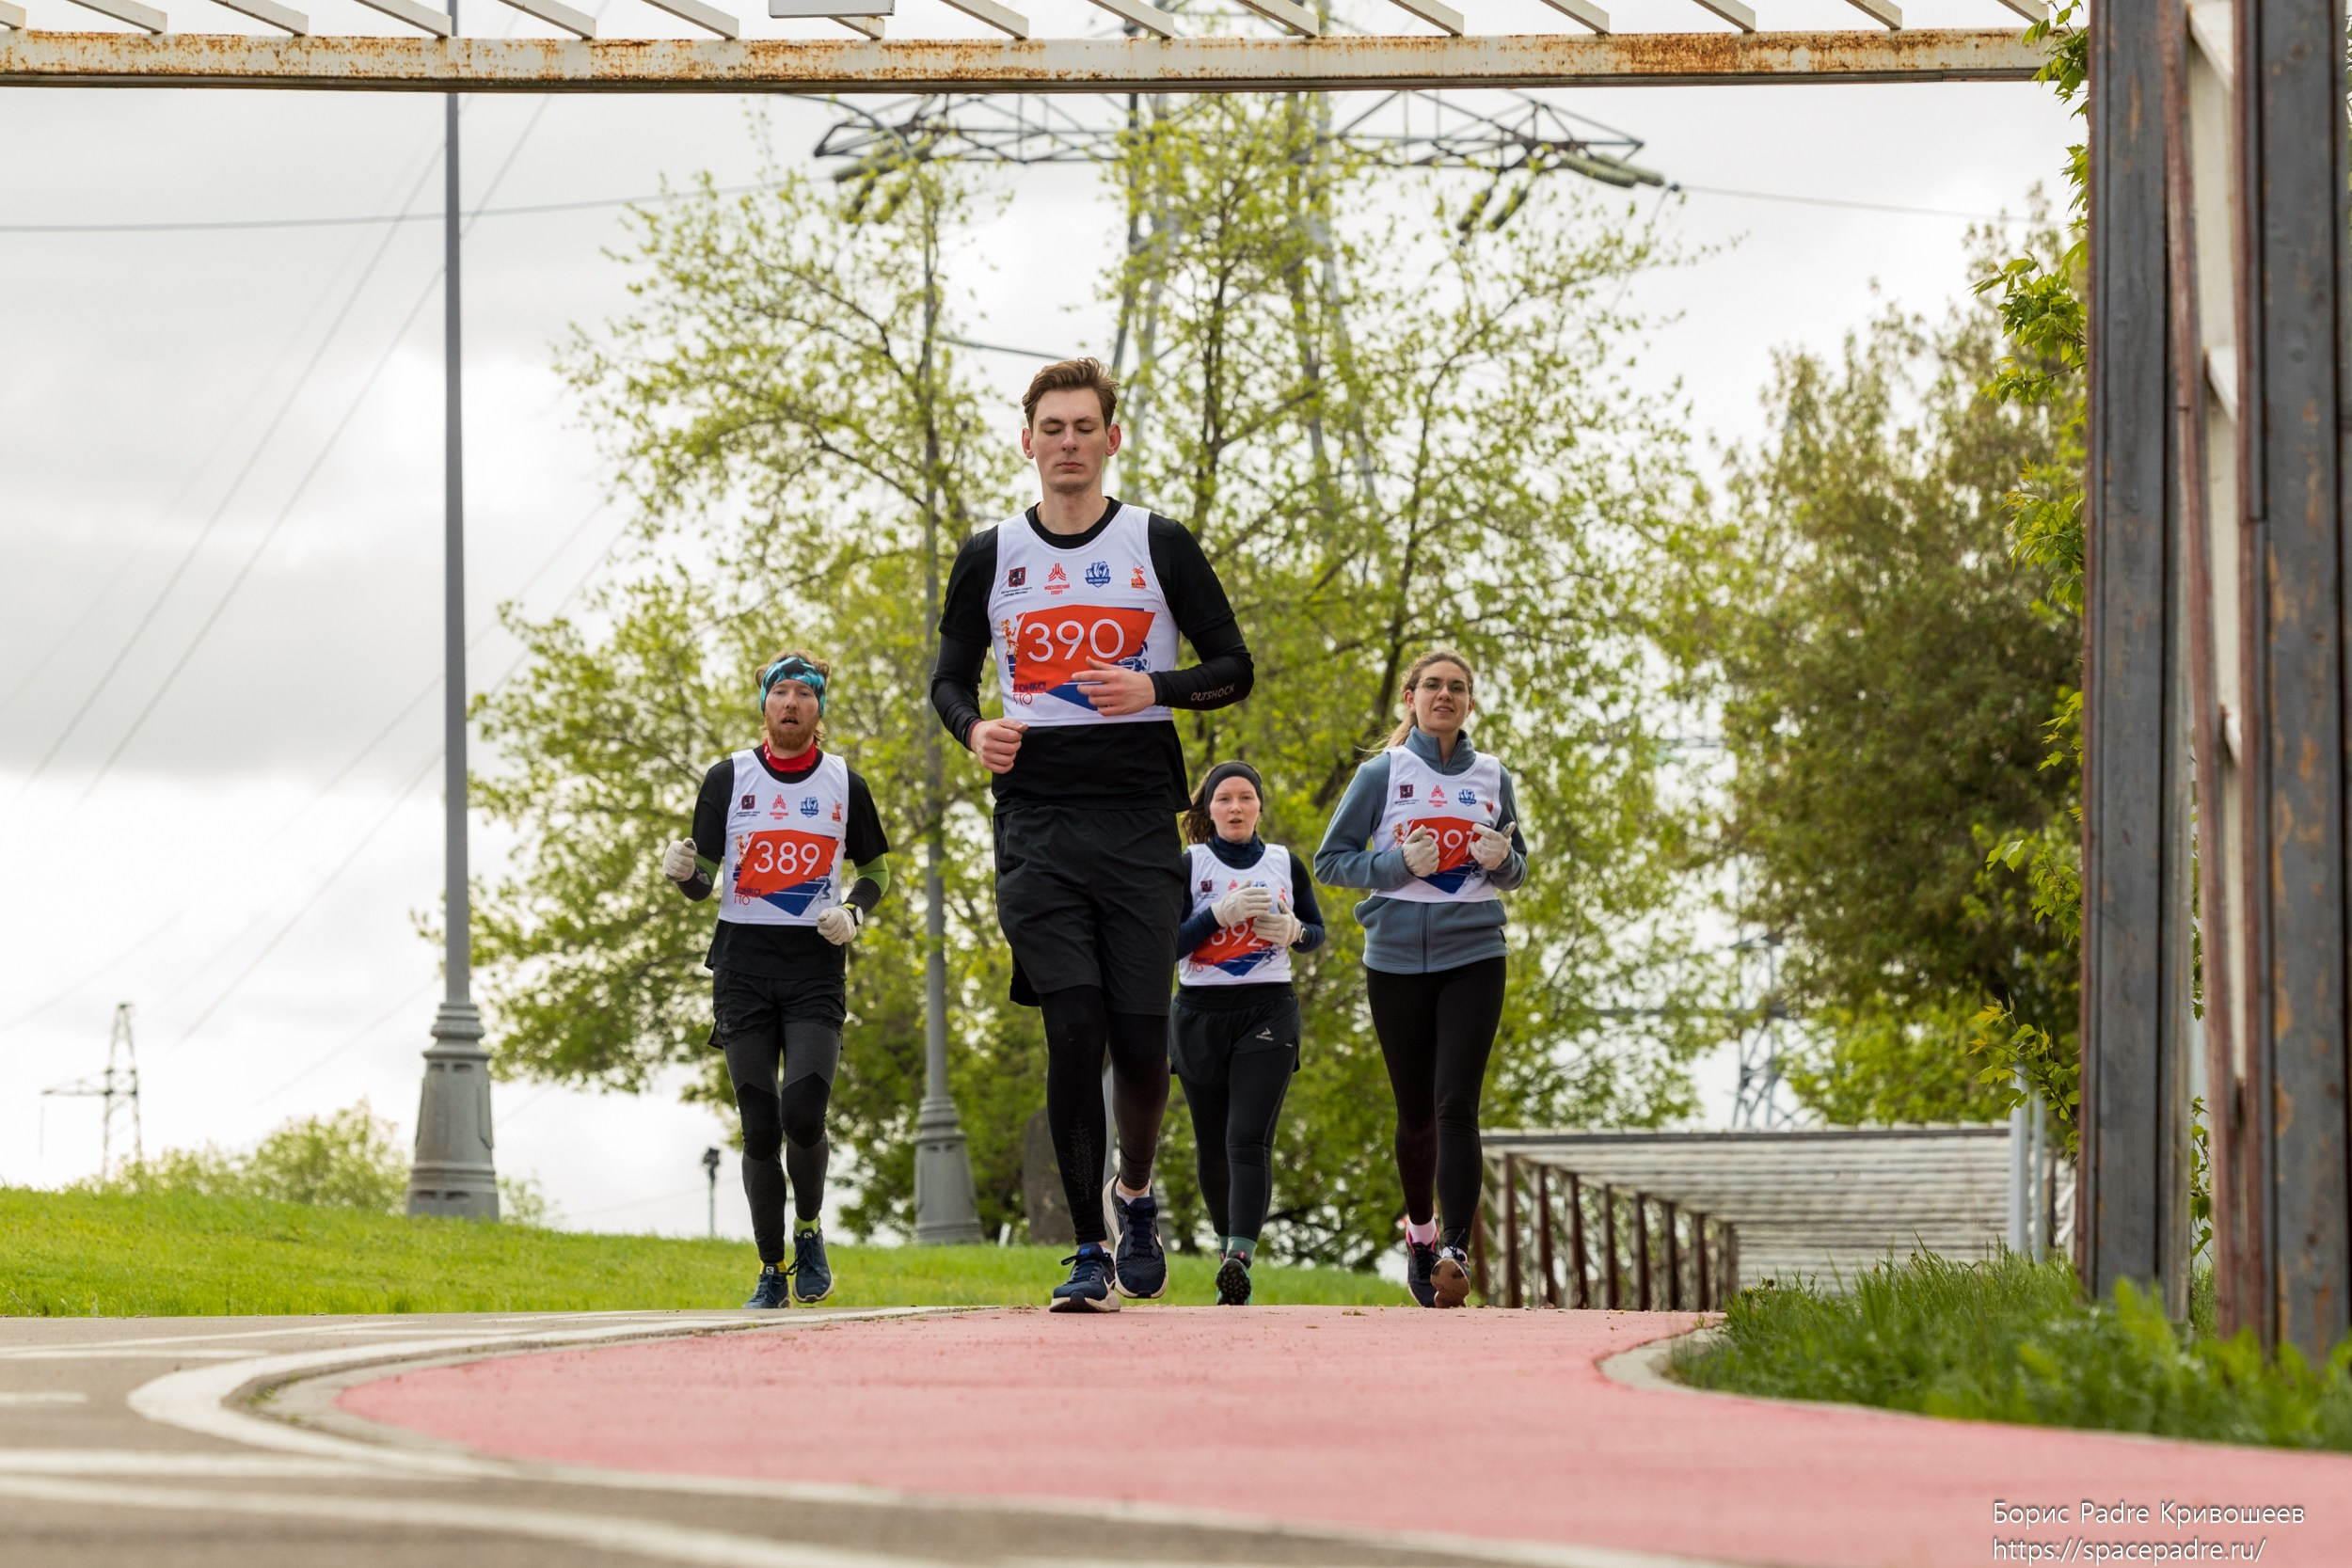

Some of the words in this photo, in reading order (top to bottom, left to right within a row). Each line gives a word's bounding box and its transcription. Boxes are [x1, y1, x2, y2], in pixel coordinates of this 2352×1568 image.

[1025, 619, 1124, 662] 390
[1190, 683, 1235, 702] OUTSHOCK
[754, 841, 820, 876] 389
